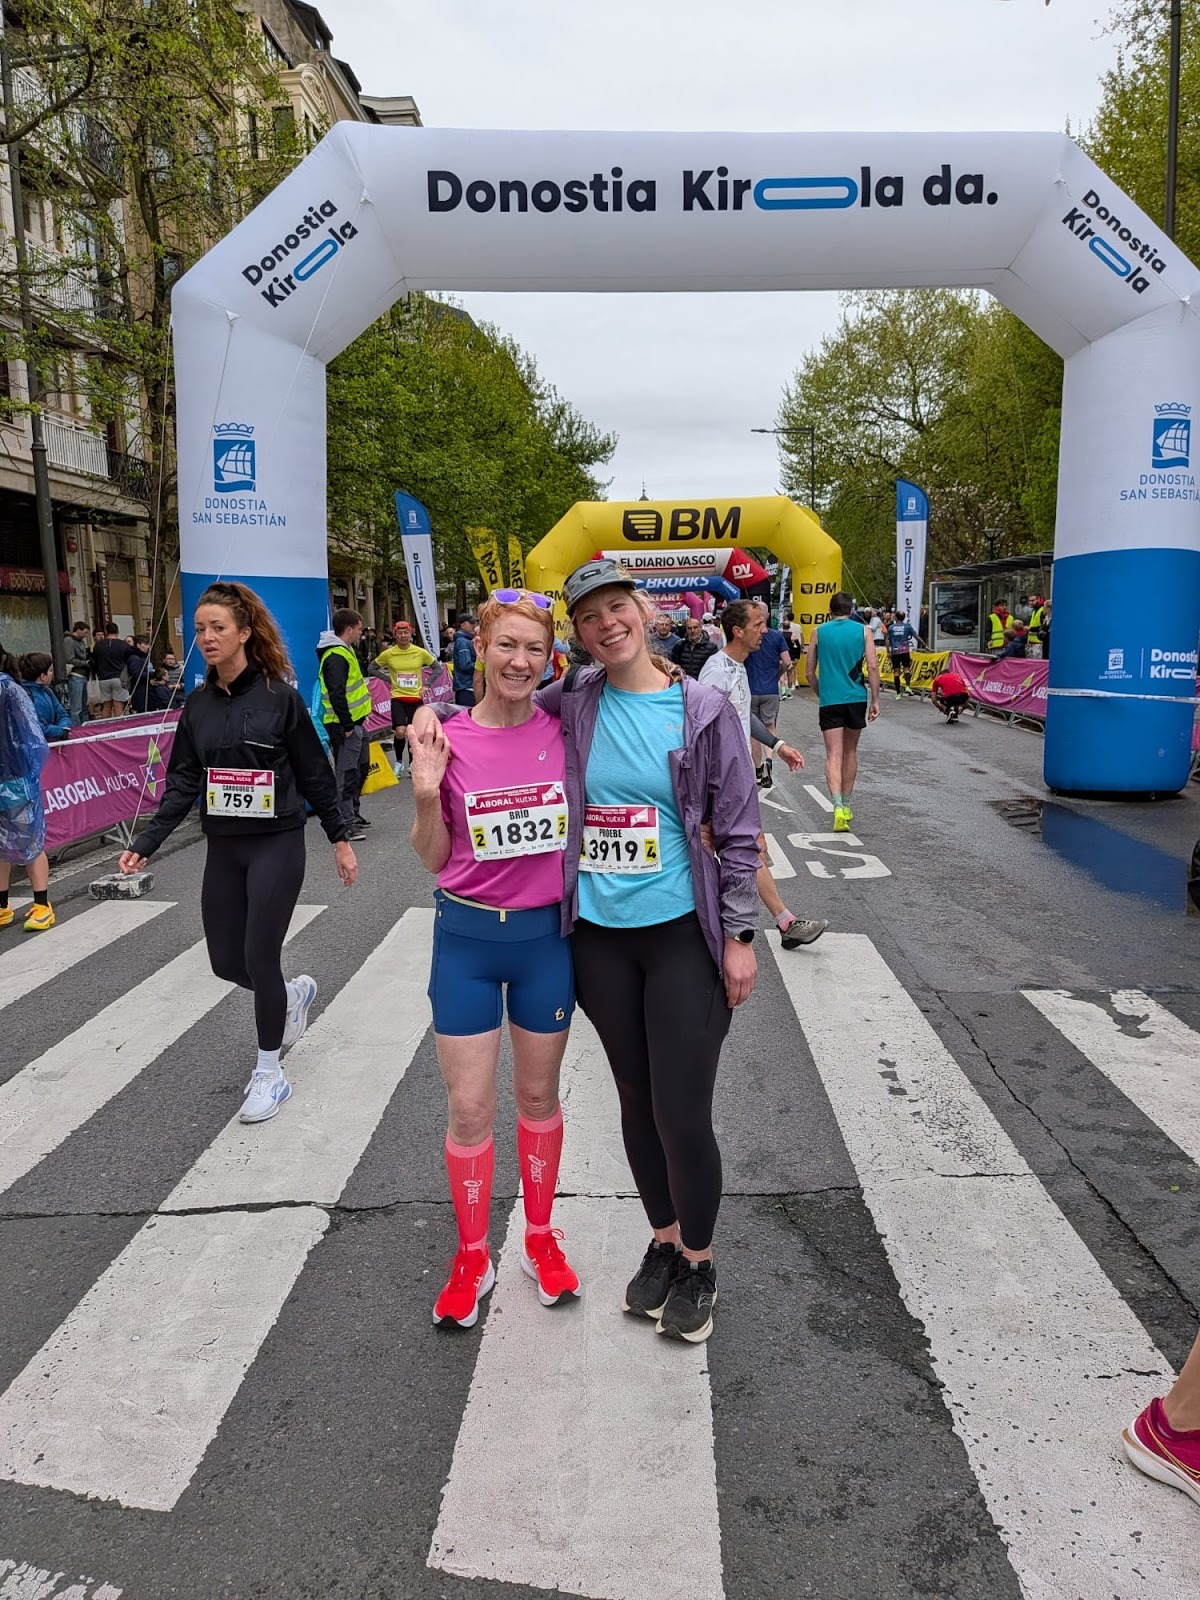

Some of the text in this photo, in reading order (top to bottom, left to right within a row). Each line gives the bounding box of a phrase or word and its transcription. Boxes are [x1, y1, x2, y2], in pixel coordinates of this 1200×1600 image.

[427, 166, 656, 213] Donostia
[922, 164, 998, 206] da.
[1082, 189, 1167, 275] Donostia
[242, 199, 338, 287] Donostia
[1139, 474, 1196, 487] DONOSTIA
[1119, 489, 1148, 501] SAN
[205, 498, 267, 511] DONOSTIA
[192, 512, 287, 527] SAN SEBASTIÁN
[668, 506, 741, 541] BM
[620, 554, 716, 568] EL DIARIO VASCO
[731, 562, 752, 578] DV
[645, 576, 710, 590] BROOKS
[815, 581, 837, 595] BM
[103, 771, 140, 794] kutxa
[209, 792, 270, 809] 1 759 1
[475, 795, 538, 810] LABORAL kutxa
[606, 815, 626, 823] kutxa
[475, 818, 566, 847] 2 1832 2
[598, 828, 623, 838] PHOEBE
[588, 838, 639, 862] 3919
[646, 846, 657, 859] 4
